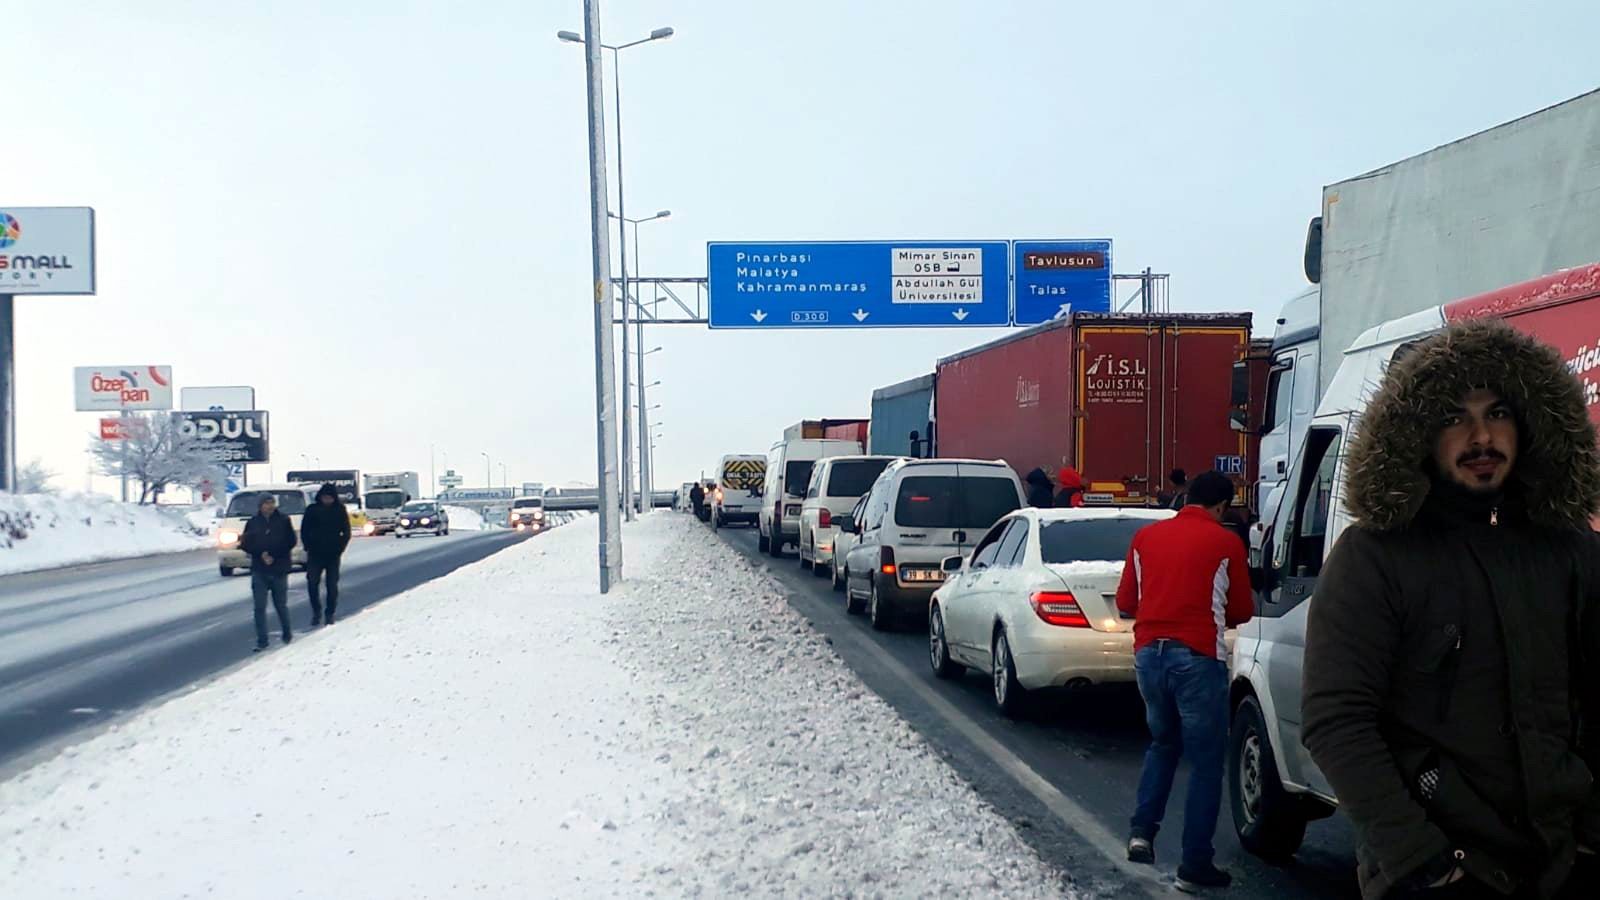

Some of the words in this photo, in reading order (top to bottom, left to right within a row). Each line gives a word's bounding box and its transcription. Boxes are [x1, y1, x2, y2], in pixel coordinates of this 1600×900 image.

[899, 251, 936, 260] Mimar
[942, 251, 975, 260] Sinan
[1029, 255, 1094, 266] Tavlusun
[737, 267, 798, 279] Malatya
[914, 263, 941, 272] OSB
[736, 282, 867, 293] Kahramanmaraş
[895, 279, 954, 288] Abdullah
[959, 279, 980, 288] Gül
[899, 291, 976, 300] Üniversitesi
[1029, 285, 1066, 295] Talas
[91, 372, 128, 392] Özer
[121, 389, 149, 405] pan
[1217, 456, 1242, 472] TIR
